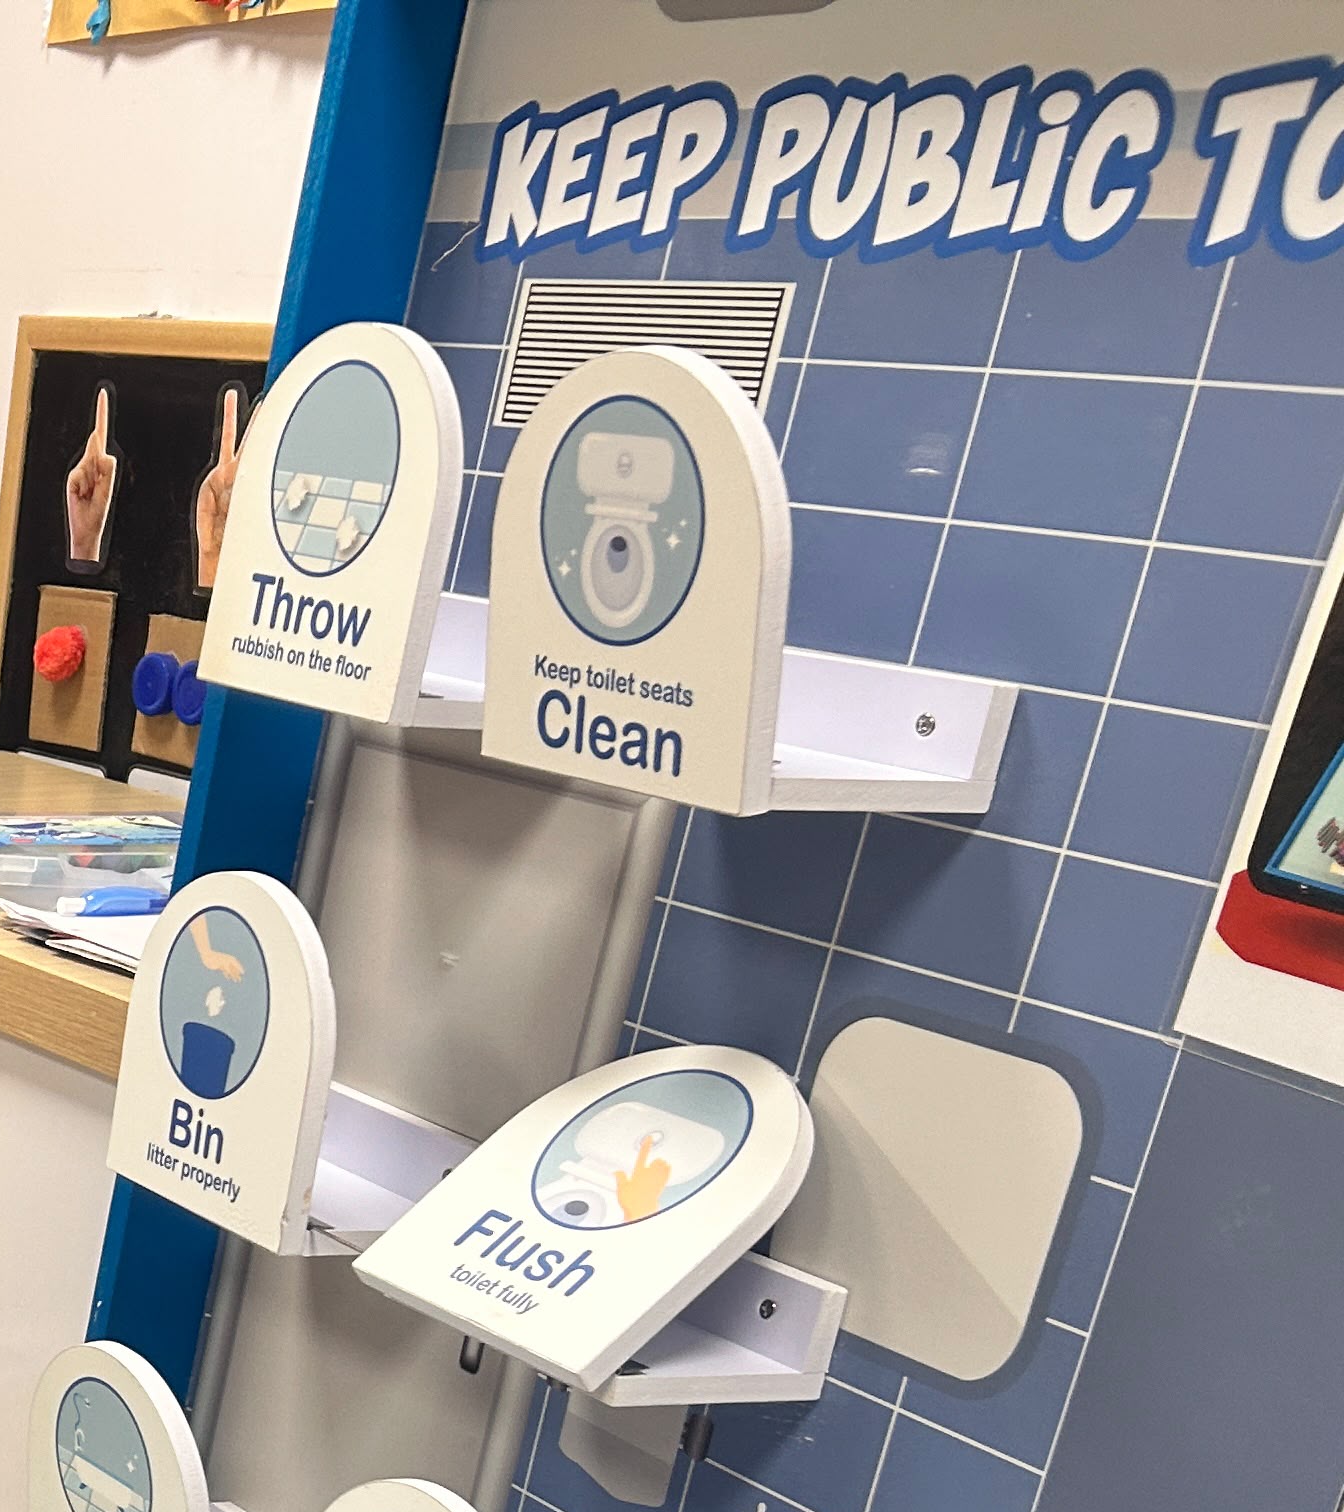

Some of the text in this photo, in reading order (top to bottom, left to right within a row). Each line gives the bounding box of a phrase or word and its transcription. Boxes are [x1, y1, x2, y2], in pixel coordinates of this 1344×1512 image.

[480, 92, 731, 254] KEEP
[1200, 70, 1344, 255] TO
[252, 573, 372, 647] Throw
[231, 635, 372, 681] rubbish on the floor
[534, 654, 694, 708] Keep toilet seats
[537, 689, 683, 778] Clean
[169, 1098, 224, 1165] Bin
[146, 1142, 241, 1203] litter properly
[453, 1209, 596, 1297] Flush
[449, 1264, 540, 1315] toilet fully
